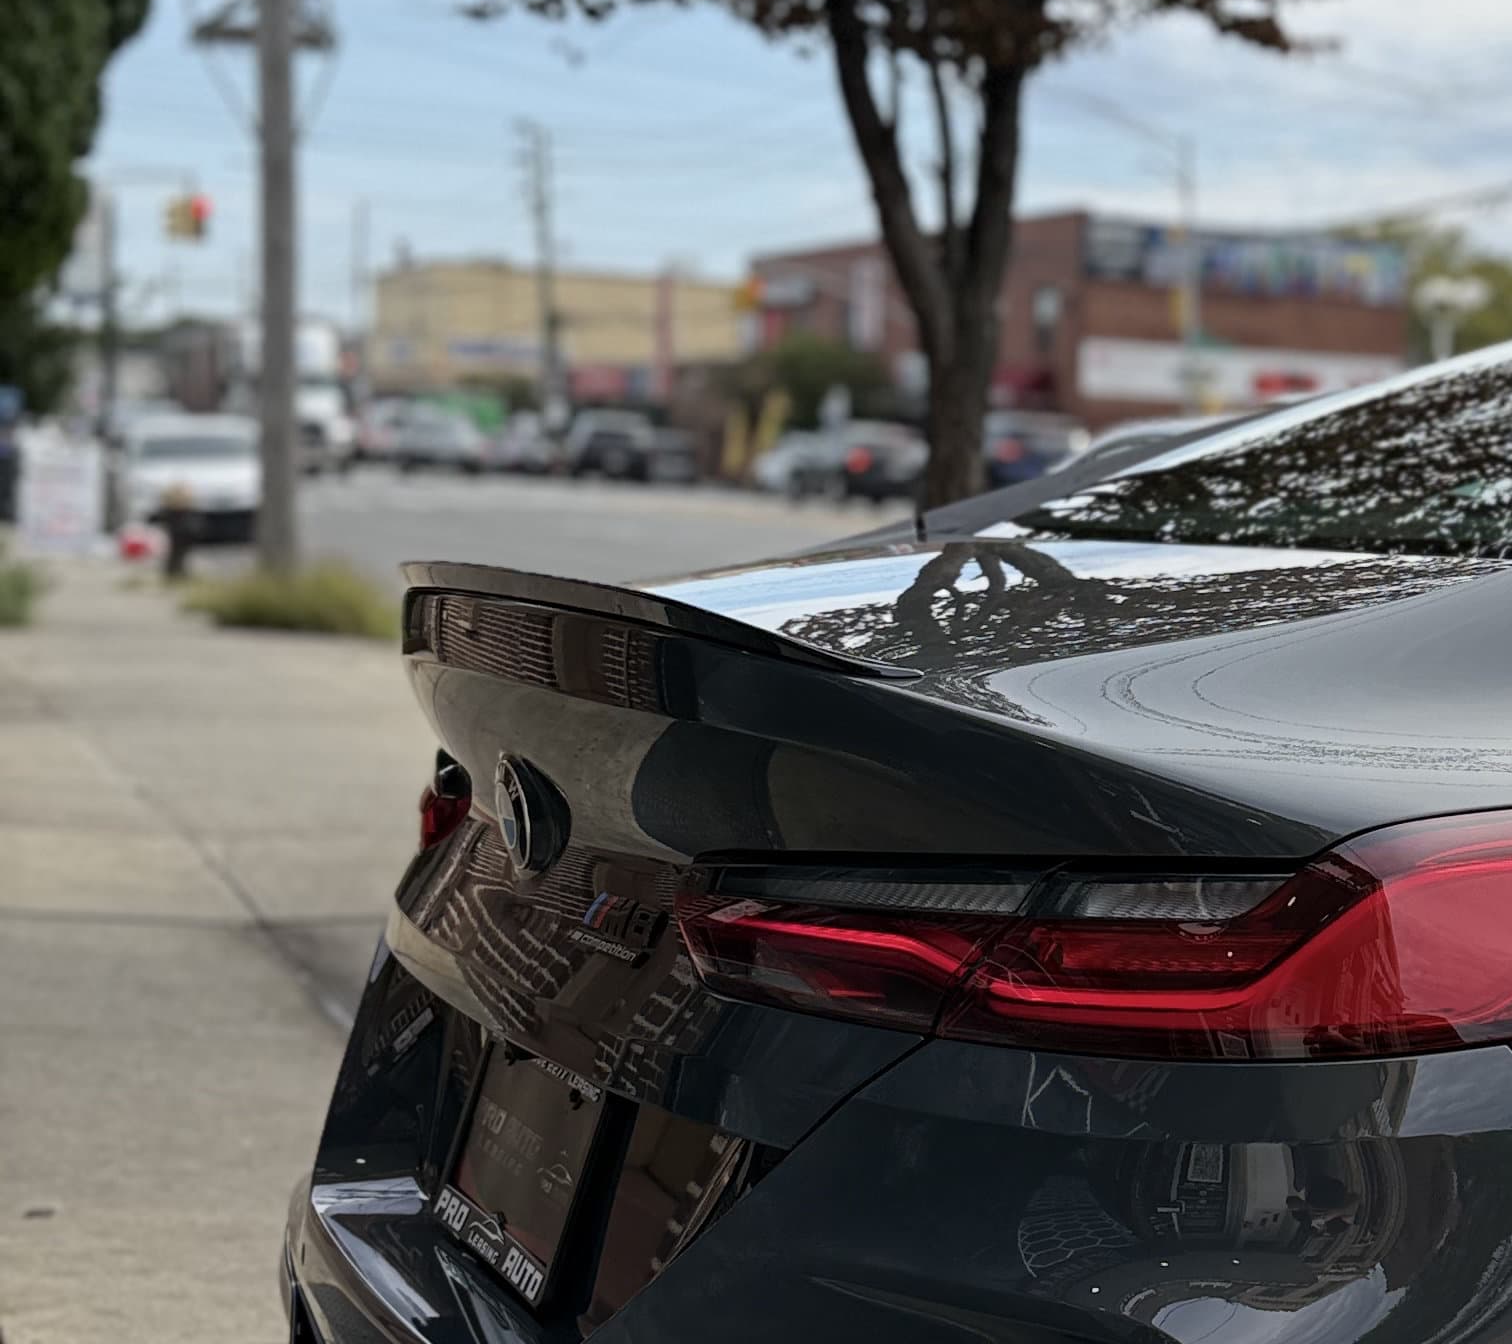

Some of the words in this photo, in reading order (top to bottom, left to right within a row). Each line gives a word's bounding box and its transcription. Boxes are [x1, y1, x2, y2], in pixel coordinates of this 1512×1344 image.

[433, 1188, 471, 1232] PRO
[467, 1231, 500, 1265] LEASING
[501, 1246, 545, 1302] AUTO
